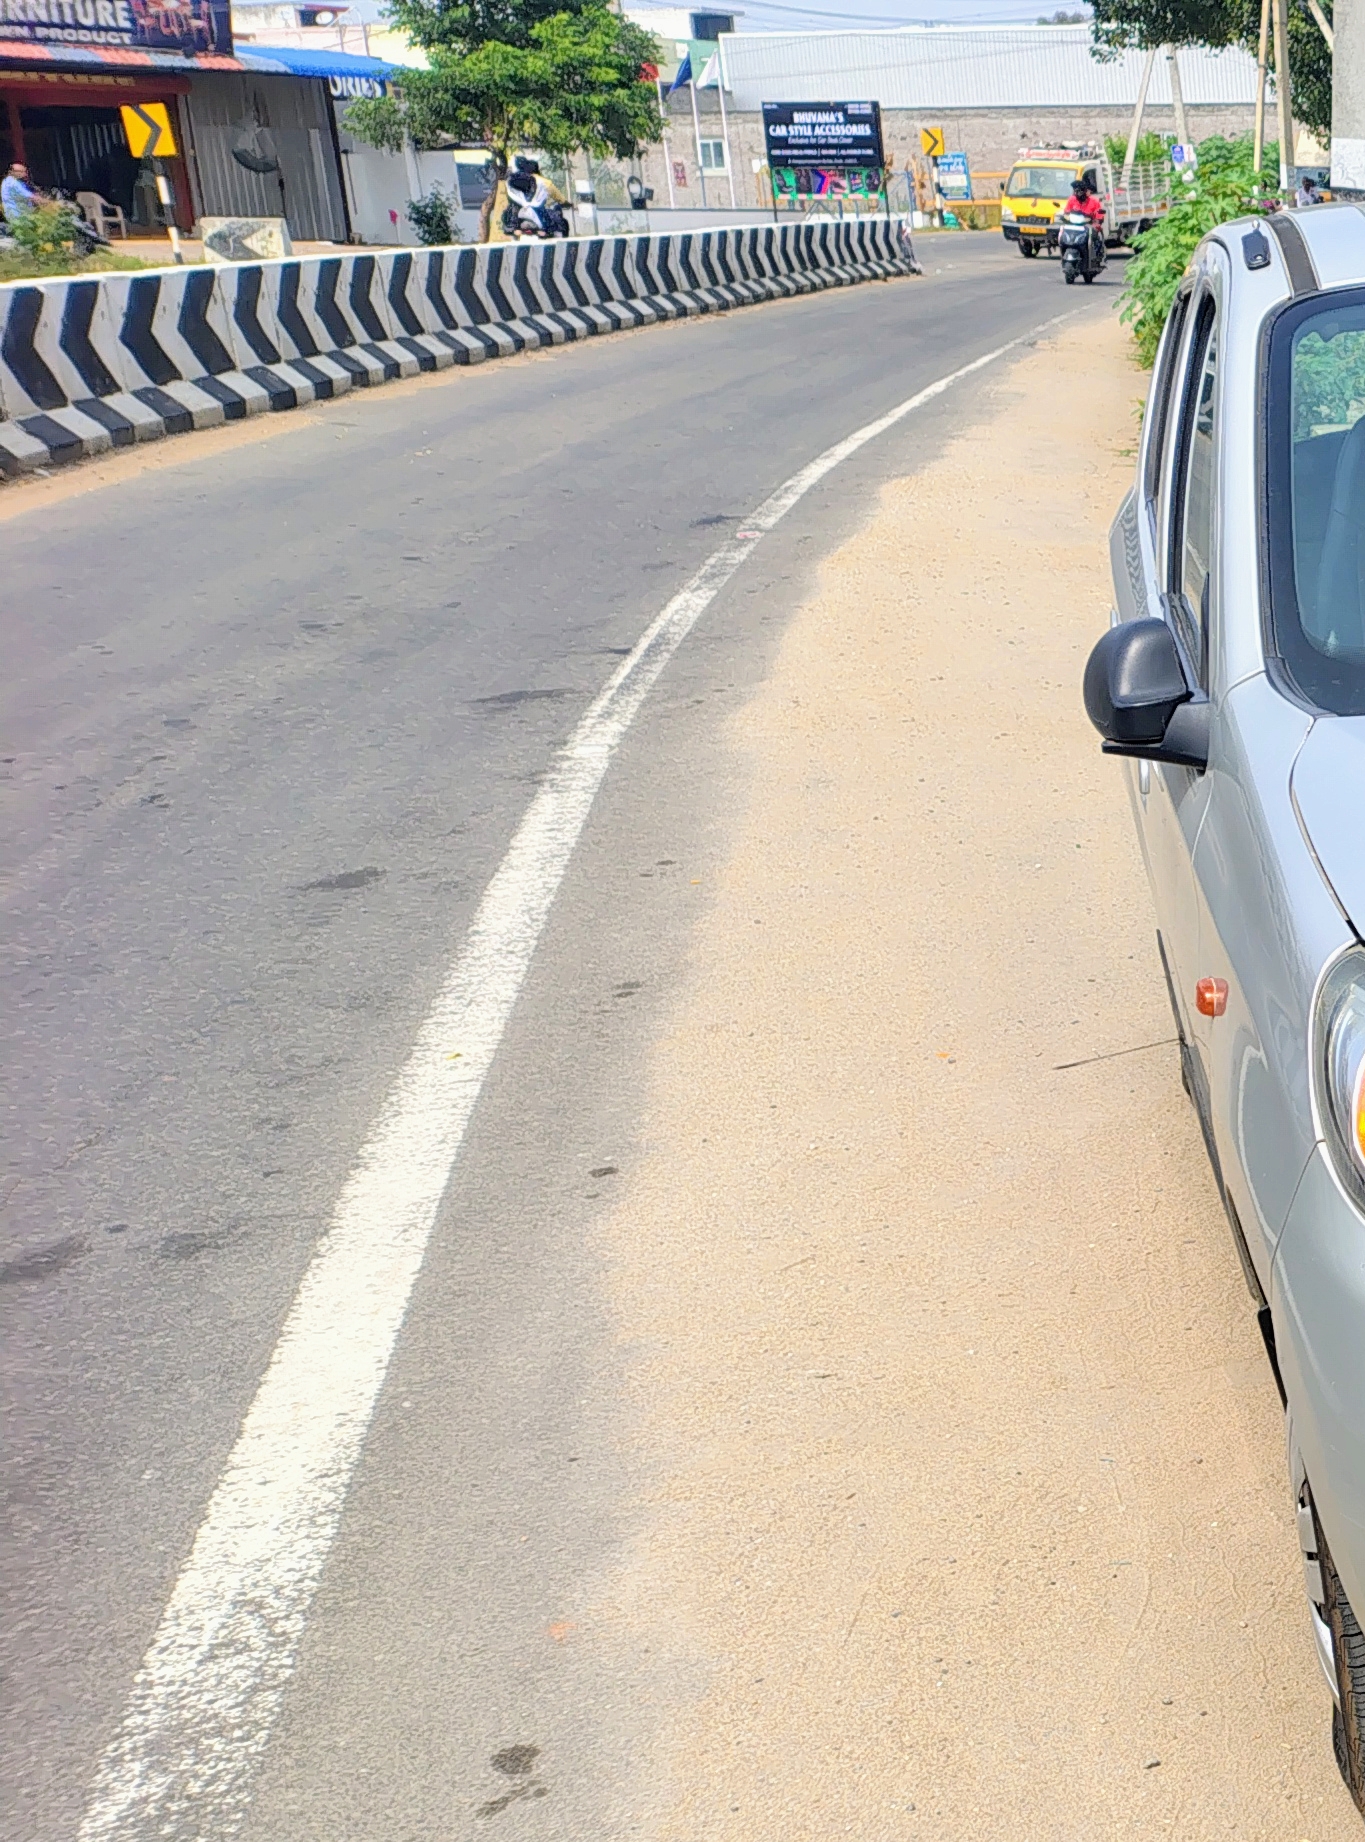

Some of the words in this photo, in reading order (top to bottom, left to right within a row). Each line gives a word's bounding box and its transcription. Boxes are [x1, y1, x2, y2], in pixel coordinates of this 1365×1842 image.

[0, 0, 133, 28] RNITURE
[34, 26, 133, 44] PRODUCT
[769, 125, 787, 136] CAR
[814, 124, 871, 135] ACCESSORIES
